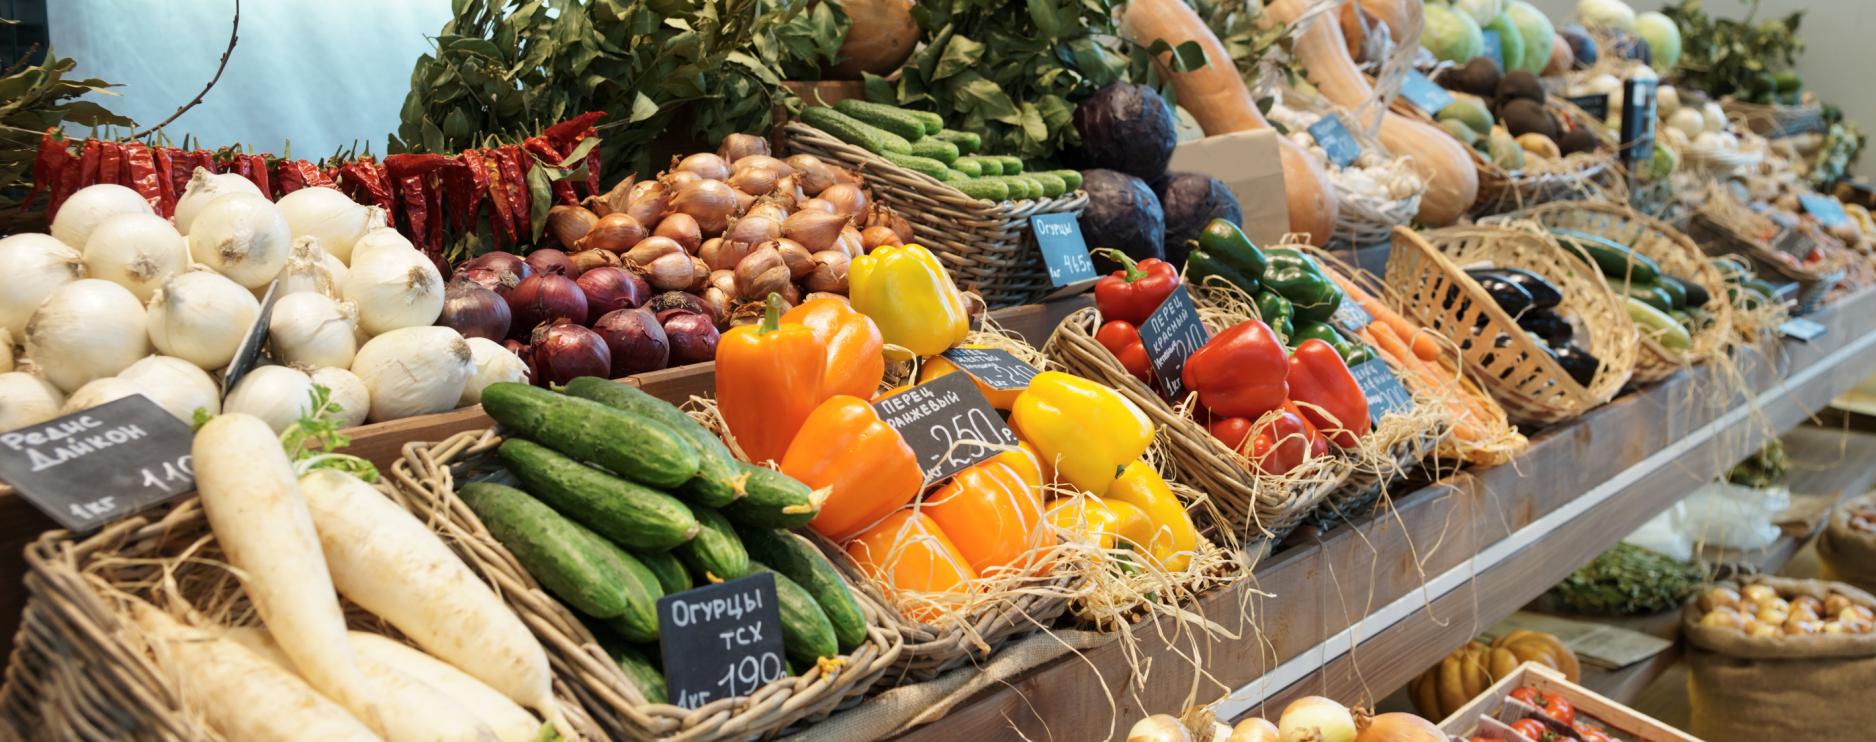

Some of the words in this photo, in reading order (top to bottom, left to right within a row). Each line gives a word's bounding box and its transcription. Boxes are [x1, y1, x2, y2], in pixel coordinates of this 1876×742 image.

[1151, 295, 1183, 334] ПЕРЕЦ
[1153, 309, 1189, 354] КРАСНЫЙ
[881, 387, 936, 415] ПЕРЕЦ
[886, 390, 961, 429] РАНЖЕВЫЙ
